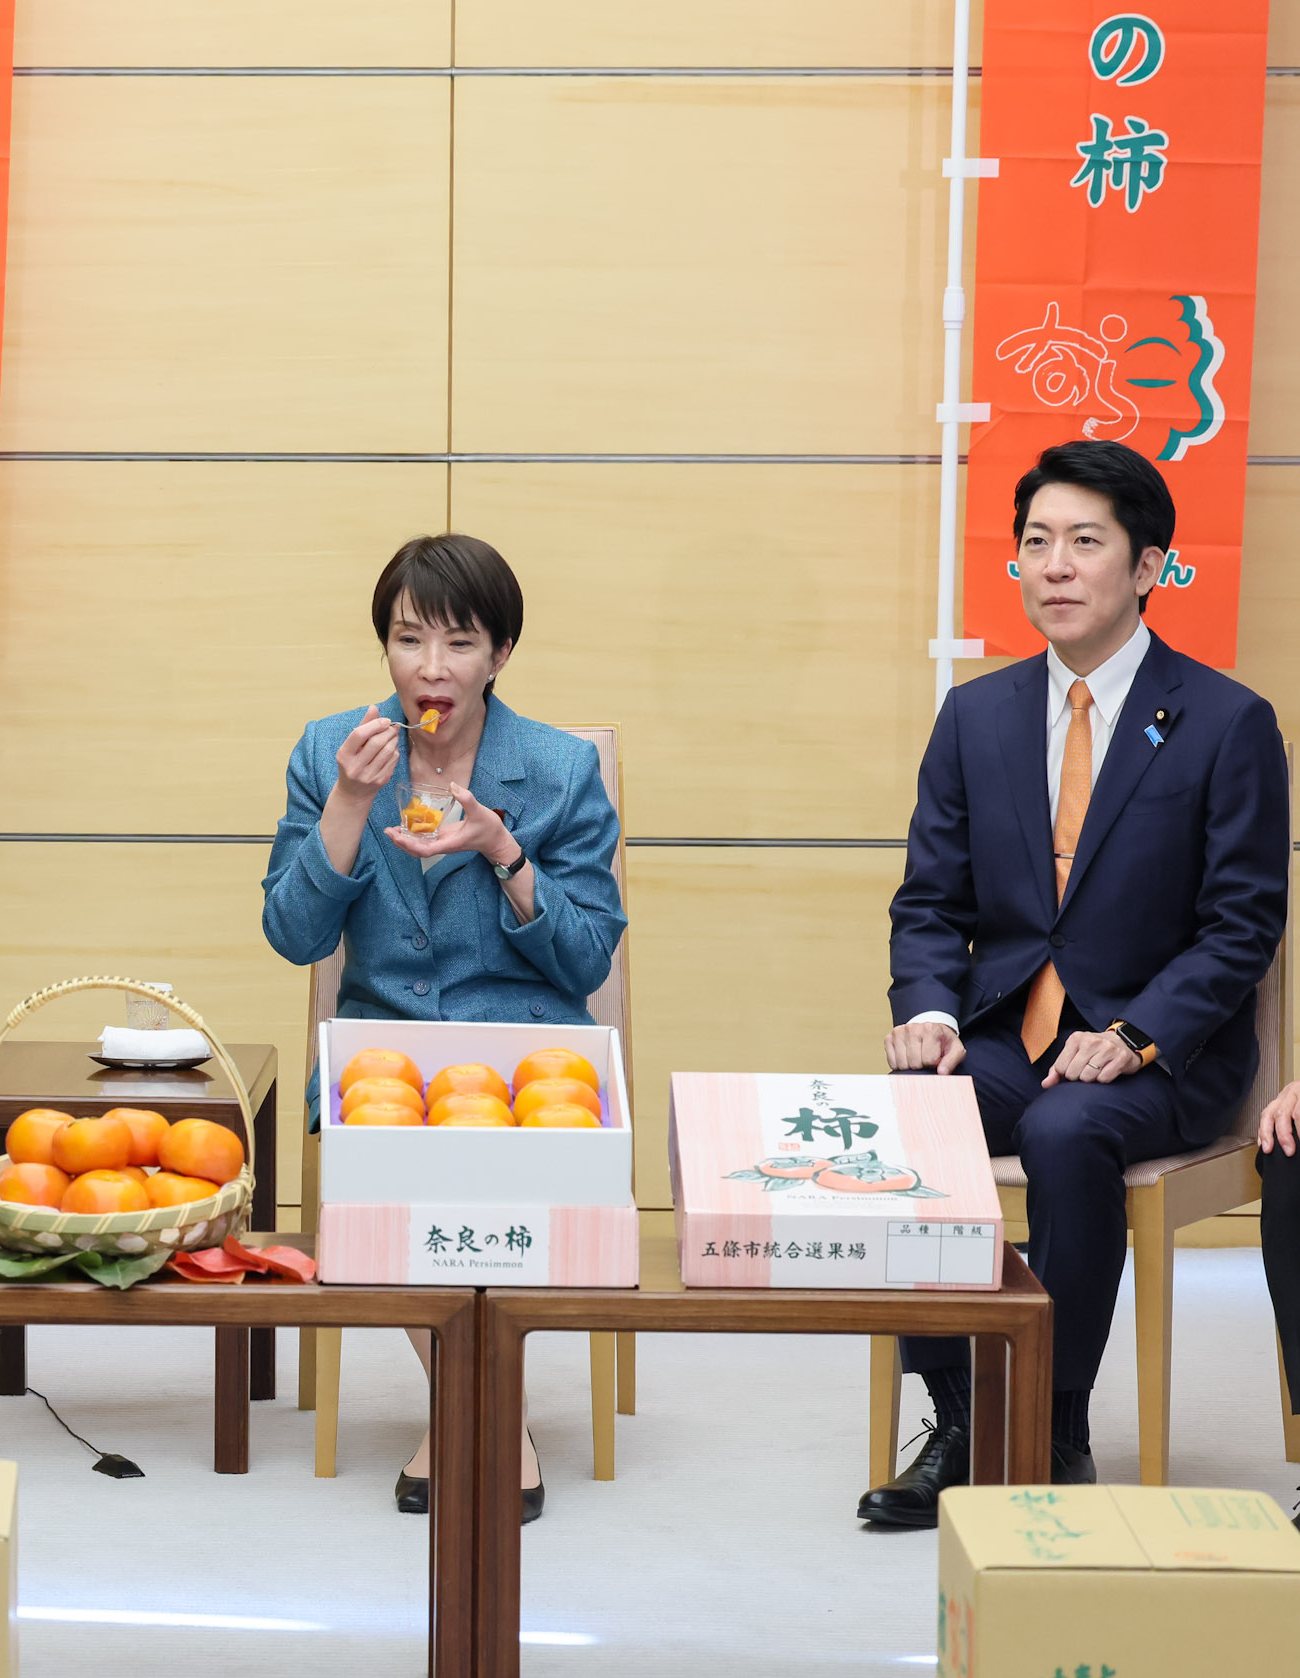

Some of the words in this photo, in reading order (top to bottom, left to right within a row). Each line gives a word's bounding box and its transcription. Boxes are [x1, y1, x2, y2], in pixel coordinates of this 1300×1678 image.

[1070, 13, 1169, 213] の柿
[424, 1224, 532, 1257] 奈良の柿
[701, 1241, 867, 1260] 五條市統合選果場
[432, 1259, 464, 1267] NARA
[469, 1259, 523, 1268] Persimmon
